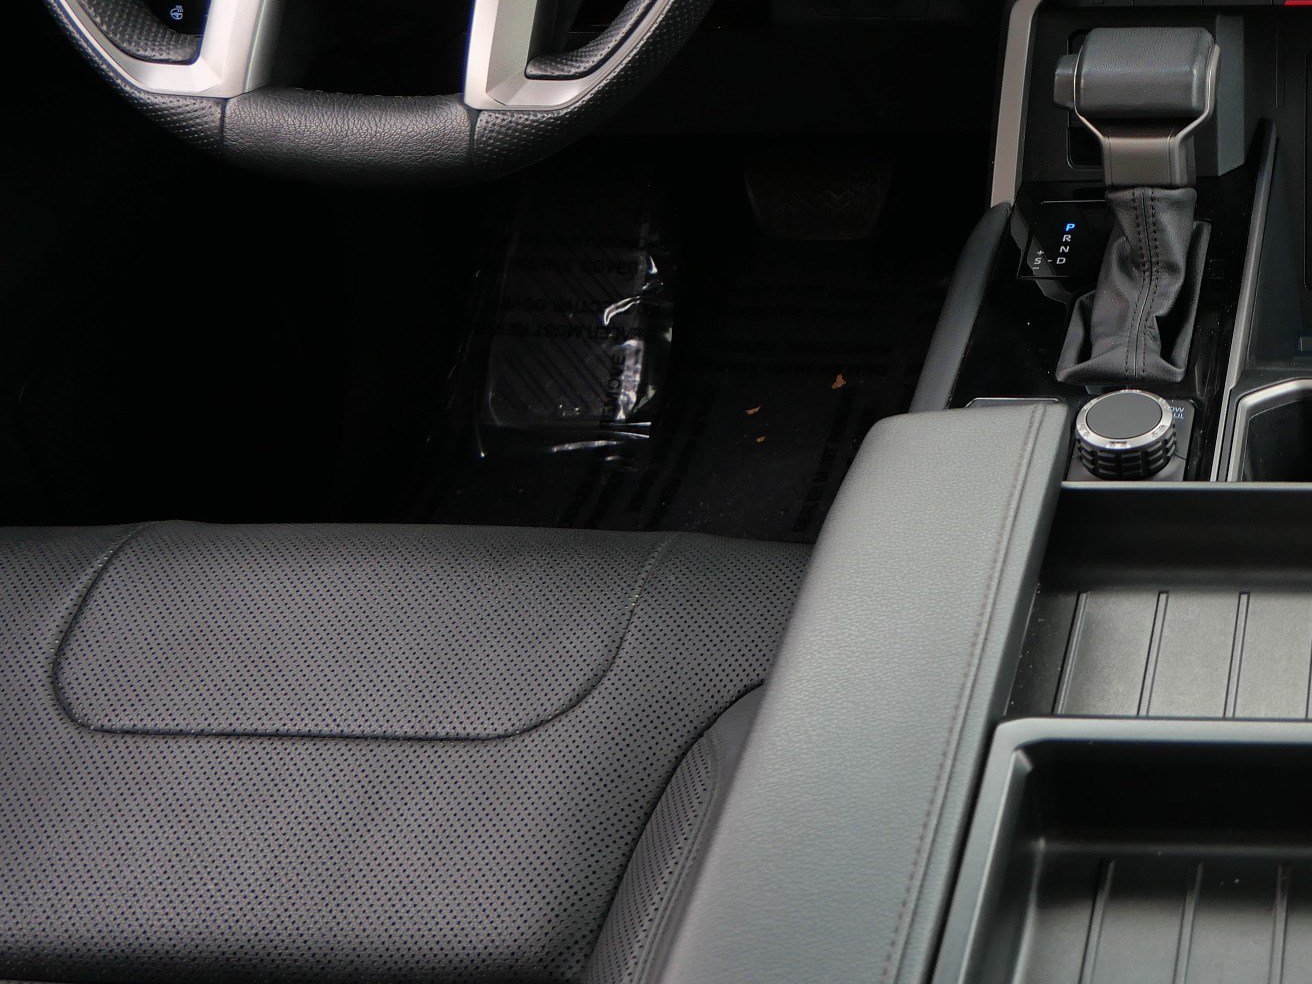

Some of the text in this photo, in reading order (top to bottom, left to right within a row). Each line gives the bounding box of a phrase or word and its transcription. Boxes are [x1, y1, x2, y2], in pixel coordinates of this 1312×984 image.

[1065, 223, 1076, 232] P
[1062, 234, 1072, 242] R
[1059, 245, 1070, 253] N
[1033, 257, 1066, 265] S D
